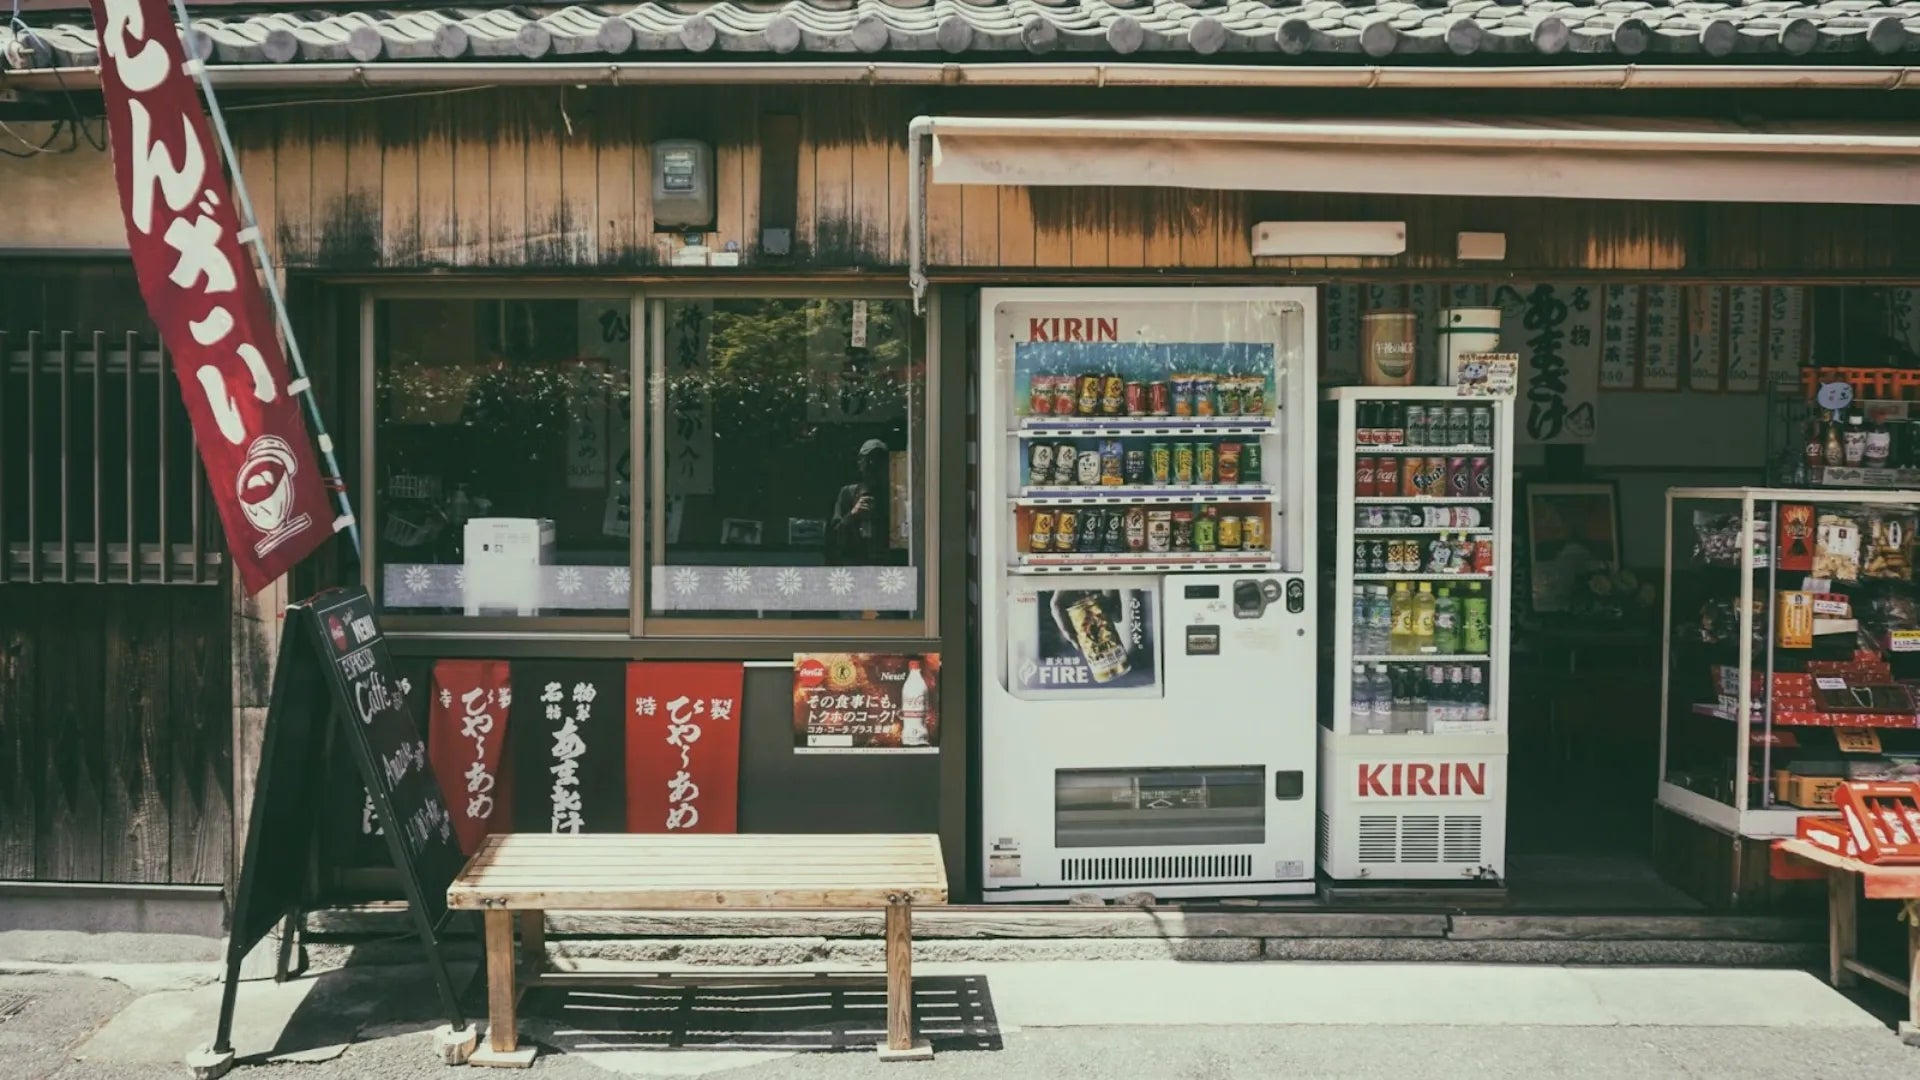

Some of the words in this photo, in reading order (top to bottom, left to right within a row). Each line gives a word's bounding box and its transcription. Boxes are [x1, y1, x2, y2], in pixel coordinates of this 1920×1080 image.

[1029, 317, 1118, 342] KIRIN
[351, 614, 376, 644] MENU
[1039, 666, 1088, 684] FIRE
[540, 681, 598, 704] 名物
[806, 694, 897, 709] その食事にも。
[808, 710, 896, 723] トクホのコーク!
[1358, 762, 1486, 797] KIRIN
